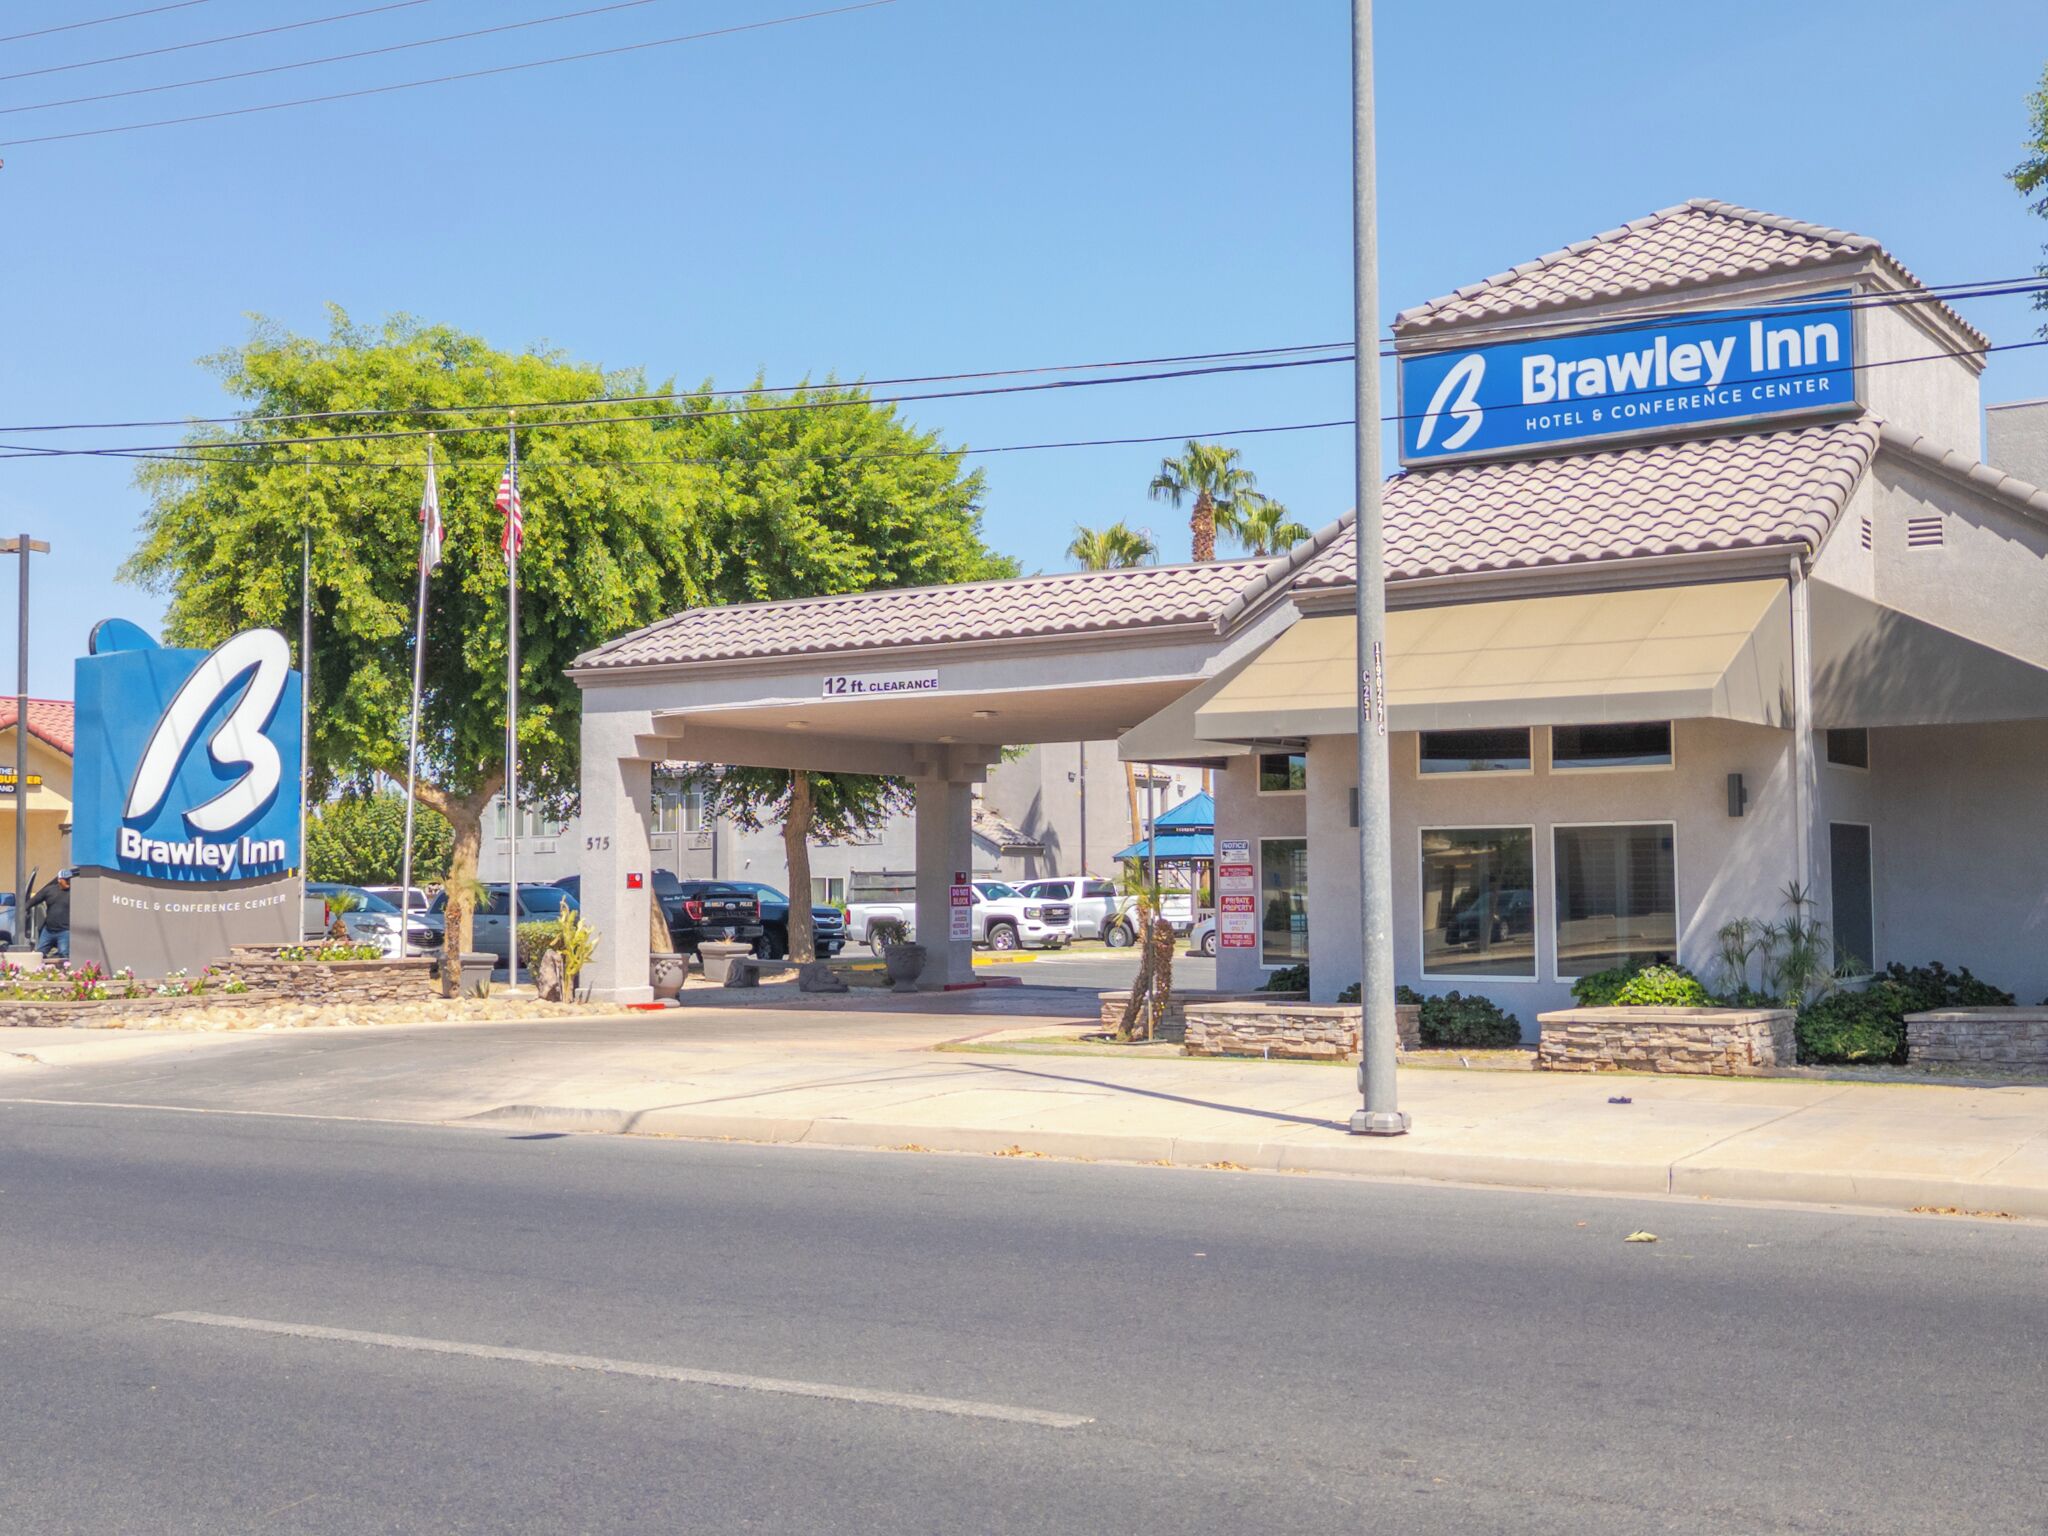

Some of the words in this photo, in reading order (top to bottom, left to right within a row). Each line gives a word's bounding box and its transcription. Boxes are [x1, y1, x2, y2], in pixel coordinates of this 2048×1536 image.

[1522, 336, 1736, 405] Brawley
[1750, 321, 1839, 372] Inn
[1526, 411, 1583, 430] HOTEL
[1592, 409, 1602, 421] &
[1611, 389, 1742, 419] CONFERENCE
[1752, 377, 1830, 400] CENTER
[824, 677, 847, 694] 12
[850, 680, 866, 693] ft.
[869, 679, 938, 692] CLEARANCE
[121, 827, 238, 873] Brawley
[242, 836, 285, 865] Inn
[586, 836, 610, 851] 575
[1222, 842, 1247, 850] NOTICE
[112, 894, 150, 910] HOTEL
[153, 902, 161, 911] &
[164, 902, 242, 913] CONFERENCE
[244, 893, 287, 910] CENTER
